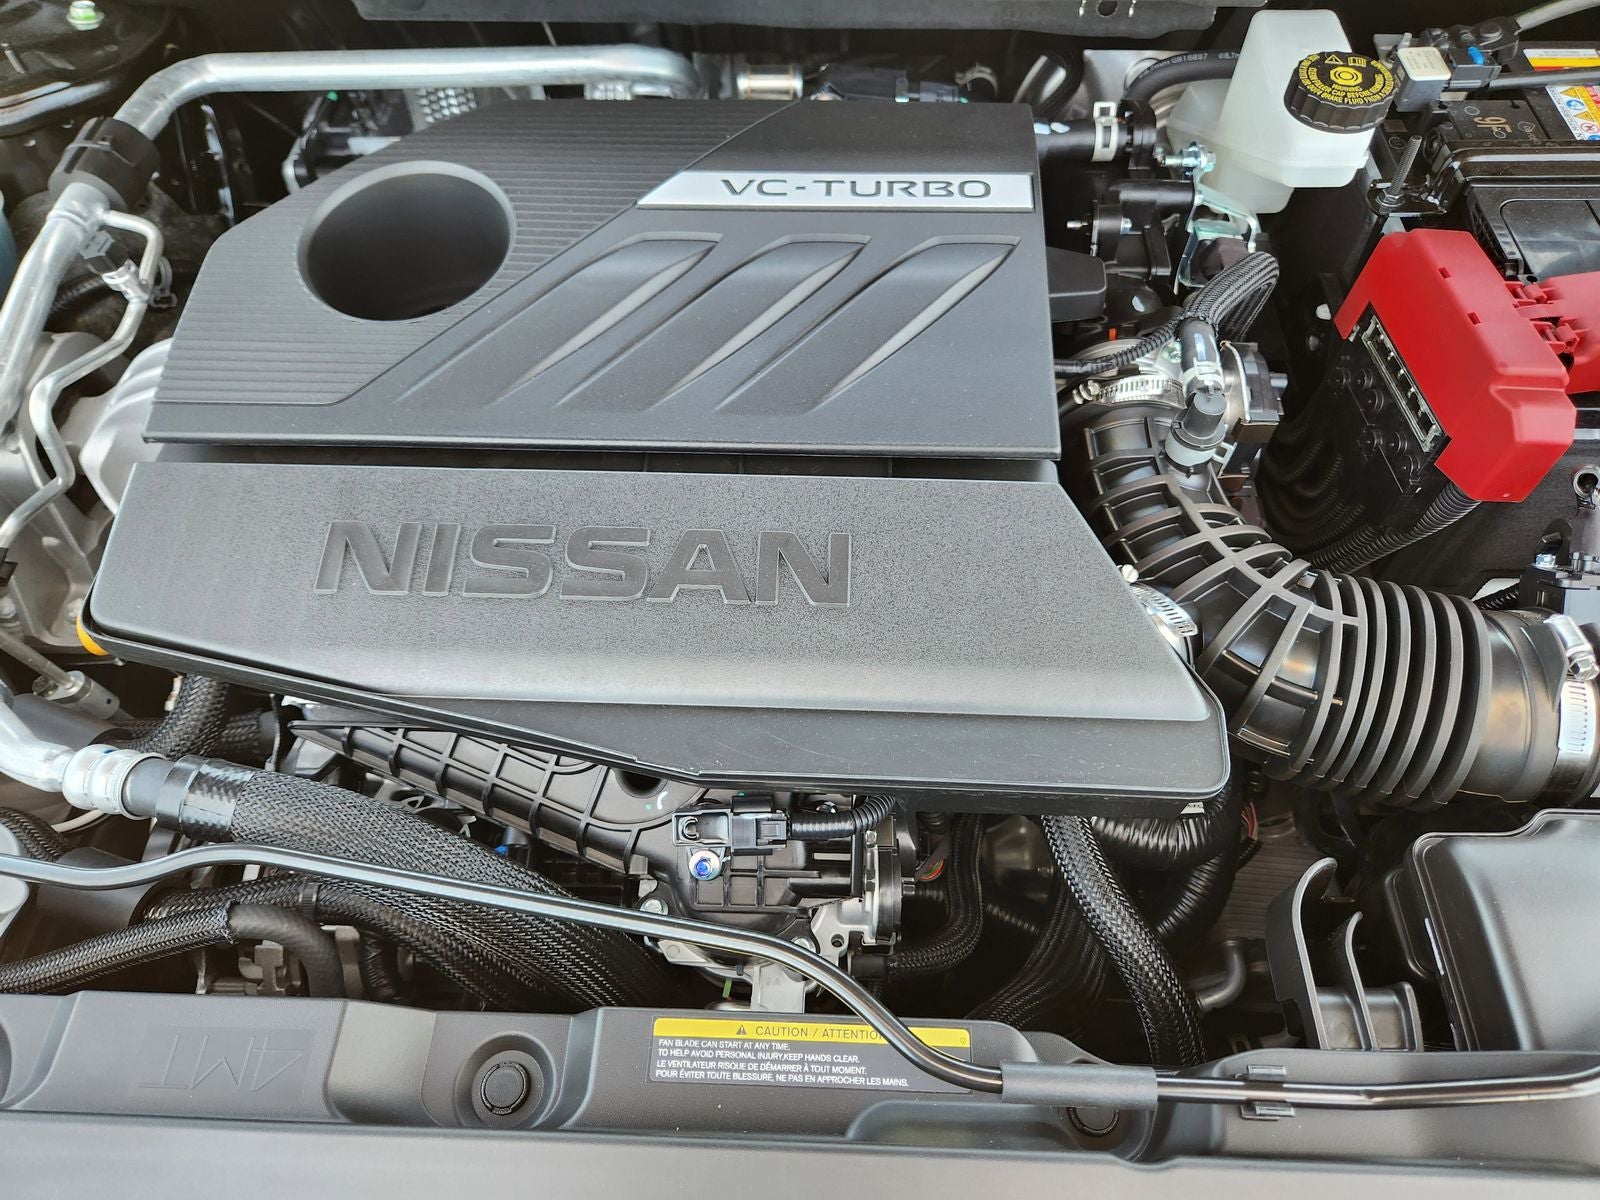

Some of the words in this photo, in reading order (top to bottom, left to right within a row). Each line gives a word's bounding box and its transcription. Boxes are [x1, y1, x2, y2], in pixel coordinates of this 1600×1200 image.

[720, 179, 992, 198] VC-TURBO
[314, 521, 852, 608] NISSAN
[755, 1026, 808, 1037] CAUTION
[812, 1028, 818, 1038] /
[659, 1039, 674, 1047] FAN
[675, 1040, 699, 1048] BLADE
[719, 1041, 742, 1049] START
[691, 1050, 714, 1058] AVOID
[716, 1051, 756, 1059] PERSONAL
[805, 1054, 831, 1062] HANDS
[833, 1055, 860, 1063] CLEAR.
[657, 1060, 666, 1068] LE
[667, 1061, 716, 1069] VENTILATEUR
[718, 1062, 746, 1071] RISQUE
[760, 1062, 801, 1072] DÉMARRER
[803, 1063, 809, 1072] À
[811, 1065, 831, 1073] TOUT
[832, 1066, 867, 1075] MOMENT.
[656, 1070, 679, 1078] POUR
[680, 1068, 705, 1079] ÉVITER
[733, 1073, 774, 1082] BLESSURE,
[817, 1076, 865, 1085] APPROCHER
[882, 1078, 909, 1086] MAINS.
